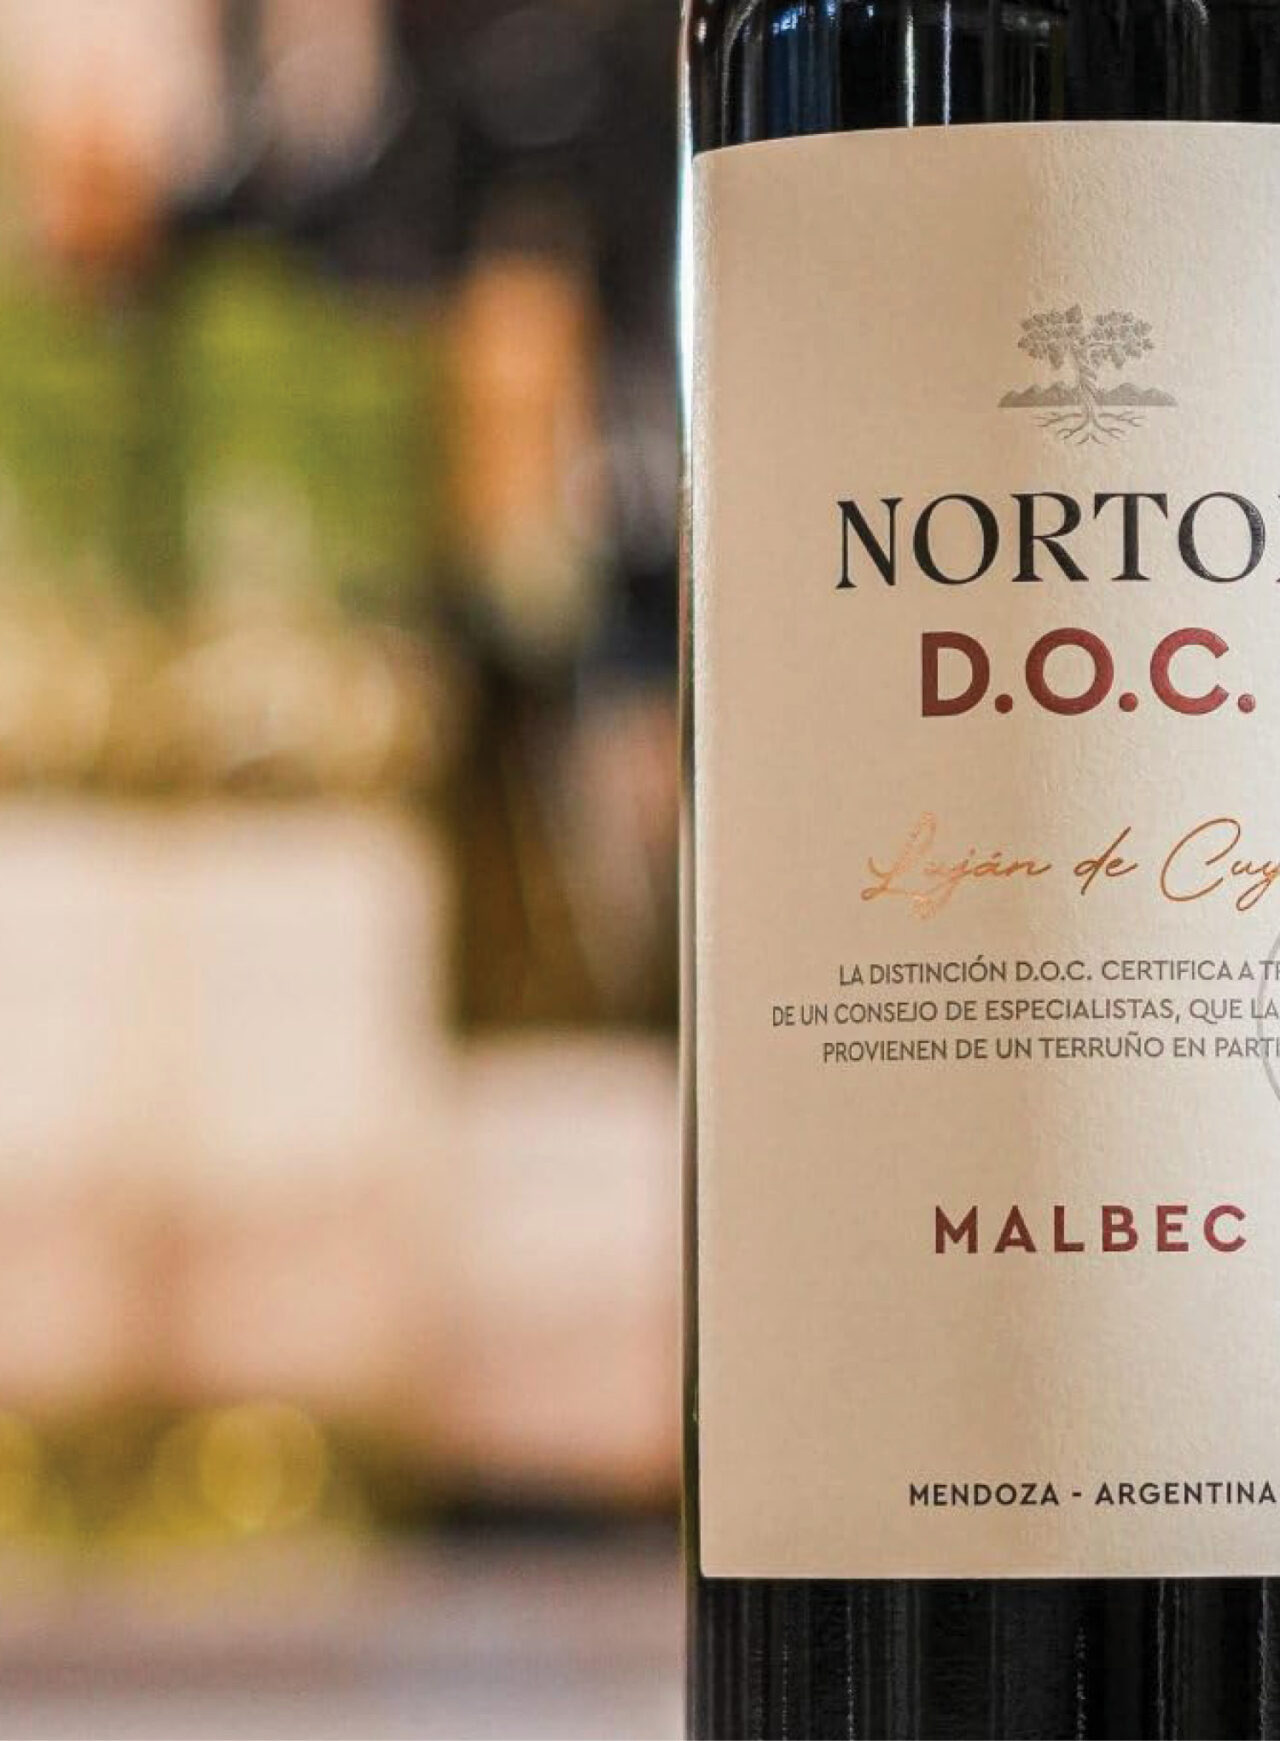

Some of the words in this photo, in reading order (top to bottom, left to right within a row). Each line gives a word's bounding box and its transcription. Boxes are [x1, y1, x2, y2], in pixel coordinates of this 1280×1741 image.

[921, 627, 1256, 718] D.O.C.
[861, 811, 1052, 921] Luján
[1073, 826, 1139, 895] de
[839, 963, 864, 986] LA
[869, 954, 1007, 985] DISTINCIÓN
[1015, 960, 1093, 982] D.O.C.
[1101, 959, 1233, 981] CERTIFICA
[1238, 960, 1255, 981] A
[772, 1005, 796, 1027] DE
[801, 1004, 828, 1025] UN
[834, 1001, 938, 1025] CONSEJO
[945, 1000, 977, 1021] DE
[985, 998, 1181, 1024] ESPECIALISTAS,
[1189, 998, 1243, 1024] QUE
[823, 1040, 948, 1063] PROVIENEN
[955, 1038, 989, 1060] DE
[996, 1037, 1033, 1059] UN
[1038, 1031, 1165, 1059] TERRUÑO
[1174, 1037, 1206, 1058] EN
[935, 1204, 1247, 1254] MALBEC
[909, 1483, 1060, 1506] MENDOZA
[1094, 1481, 1276, 1506] ARGENTINA
